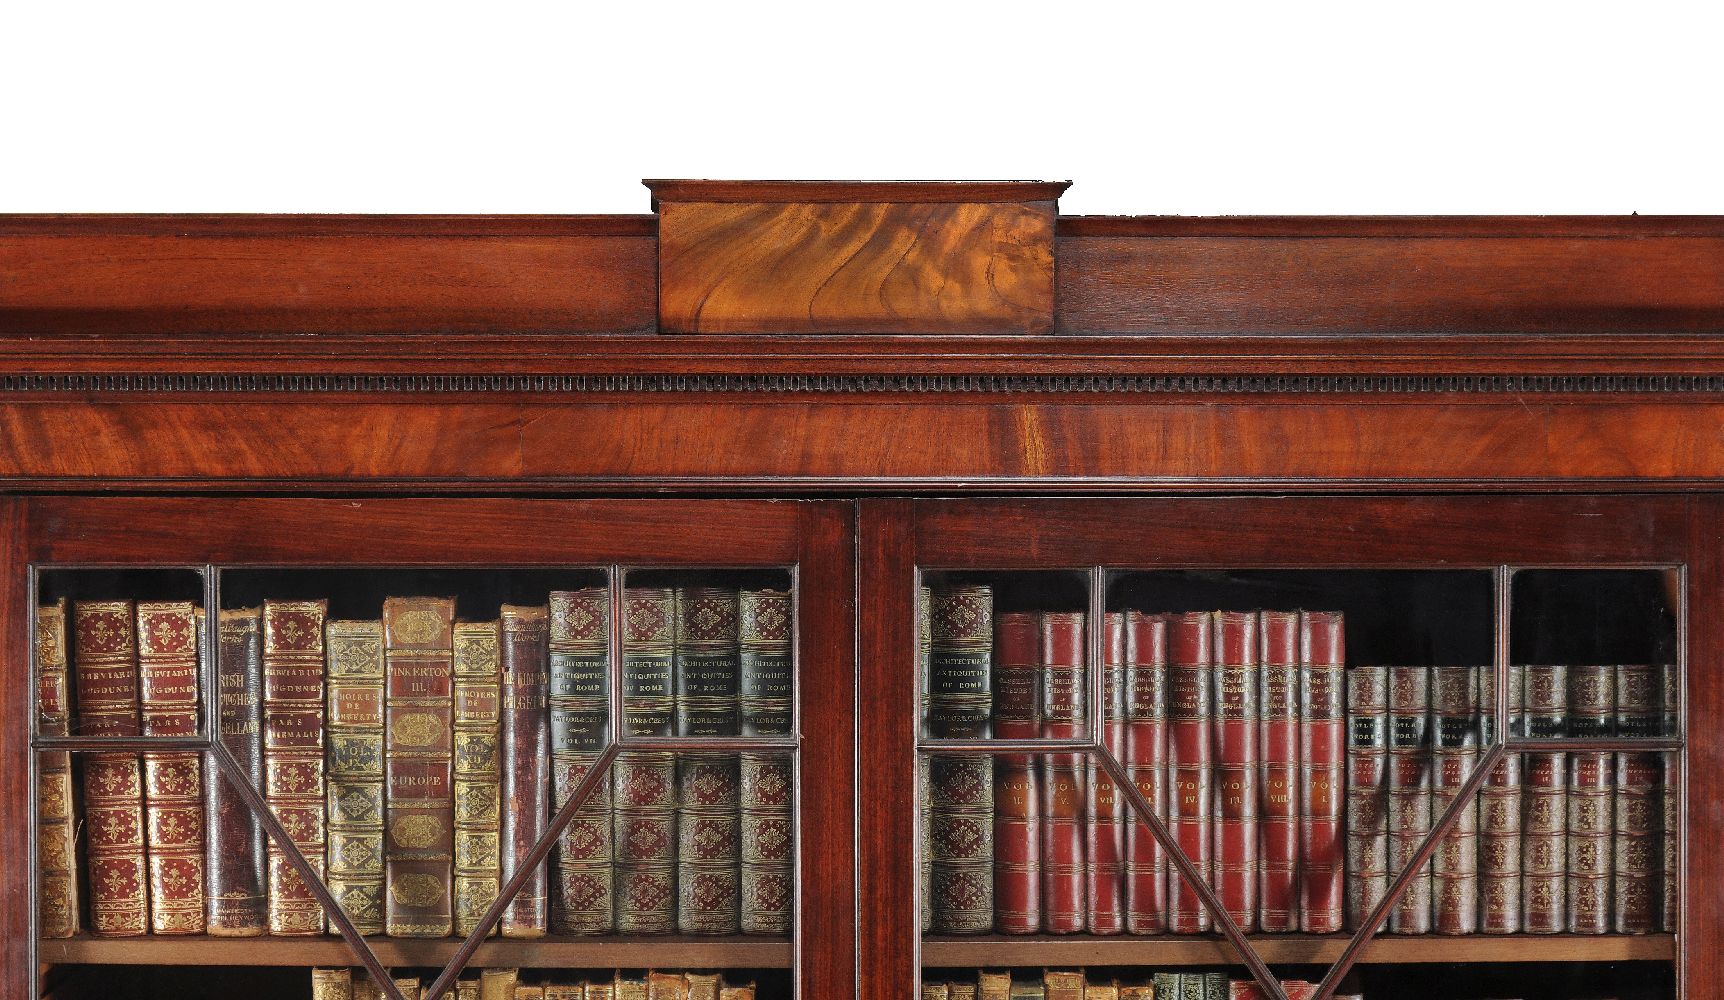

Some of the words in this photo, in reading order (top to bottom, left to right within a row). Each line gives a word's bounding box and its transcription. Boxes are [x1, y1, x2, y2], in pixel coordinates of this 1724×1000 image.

[389, 667, 449, 677] PINKERTON
[624, 672, 669, 680] NTIQUITIES
[220, 674, 245, 687] RISH
[390, 776, 441, 786] EUROPE
